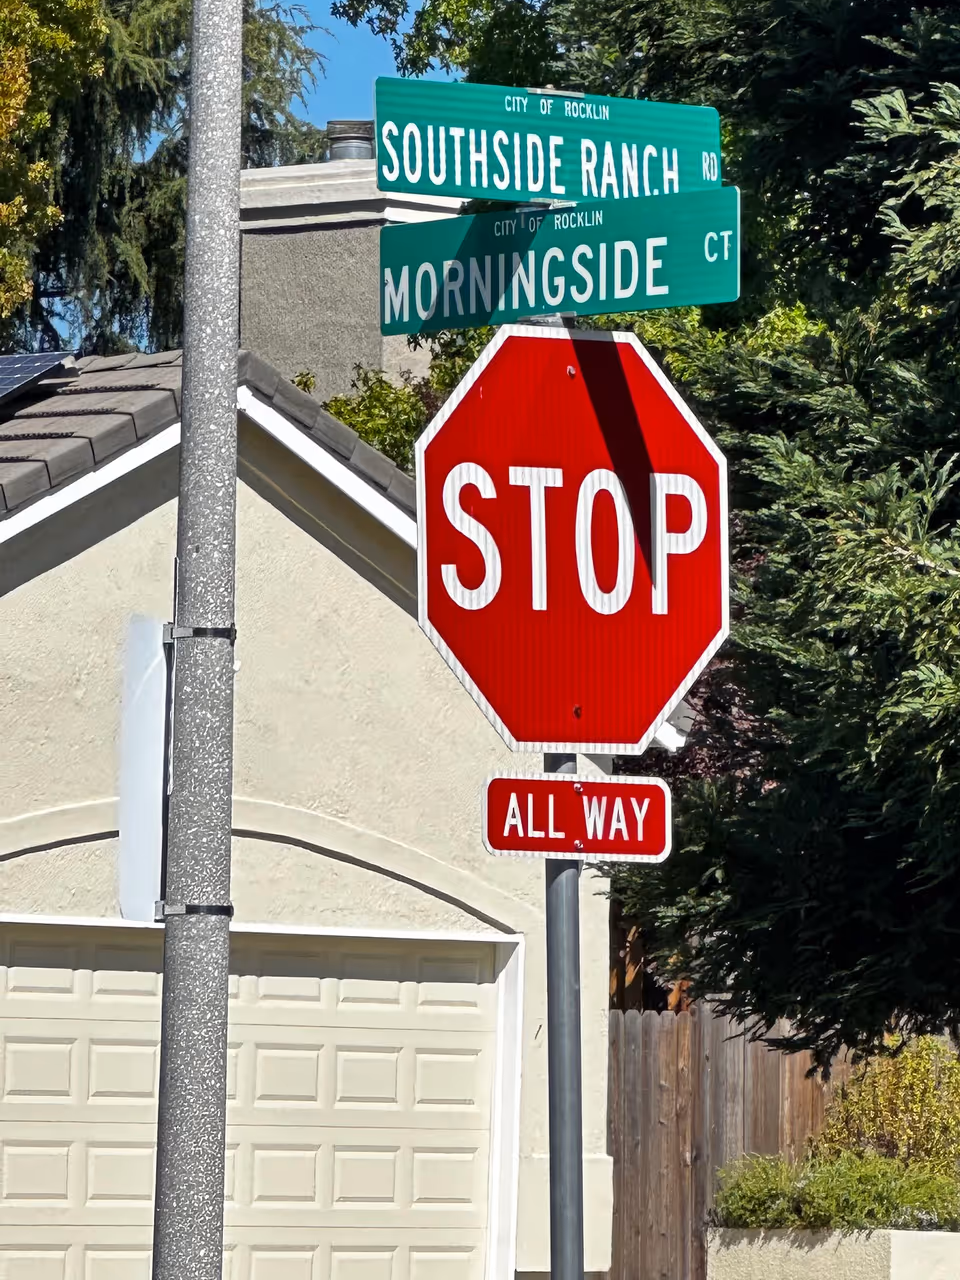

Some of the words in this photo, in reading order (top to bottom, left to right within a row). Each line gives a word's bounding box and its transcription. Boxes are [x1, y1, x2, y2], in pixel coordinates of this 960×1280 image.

[504, 95, 529, 113] CITY
[540, 100, 553, 115] OF
[564, 101, 610, 121] ROCKLIN
[381, 120, 566, 196] SOUTHSIDE
[580, 137, 680, 200] RANCH
[701, 150, 718, 182] RD
[493, 219, 517, 237] CITY
[528, 215, 543, 233] OF
[554, 210, 603, 231] ROCKLIN
[383, 235, 670, 325] MORNINGSIDE
[703, 229, 734, 263] CT
[440, 461, 708, 616] STOP
[503, 791, 566, 840] ALL
[583, 796, 651, 842] WAY
